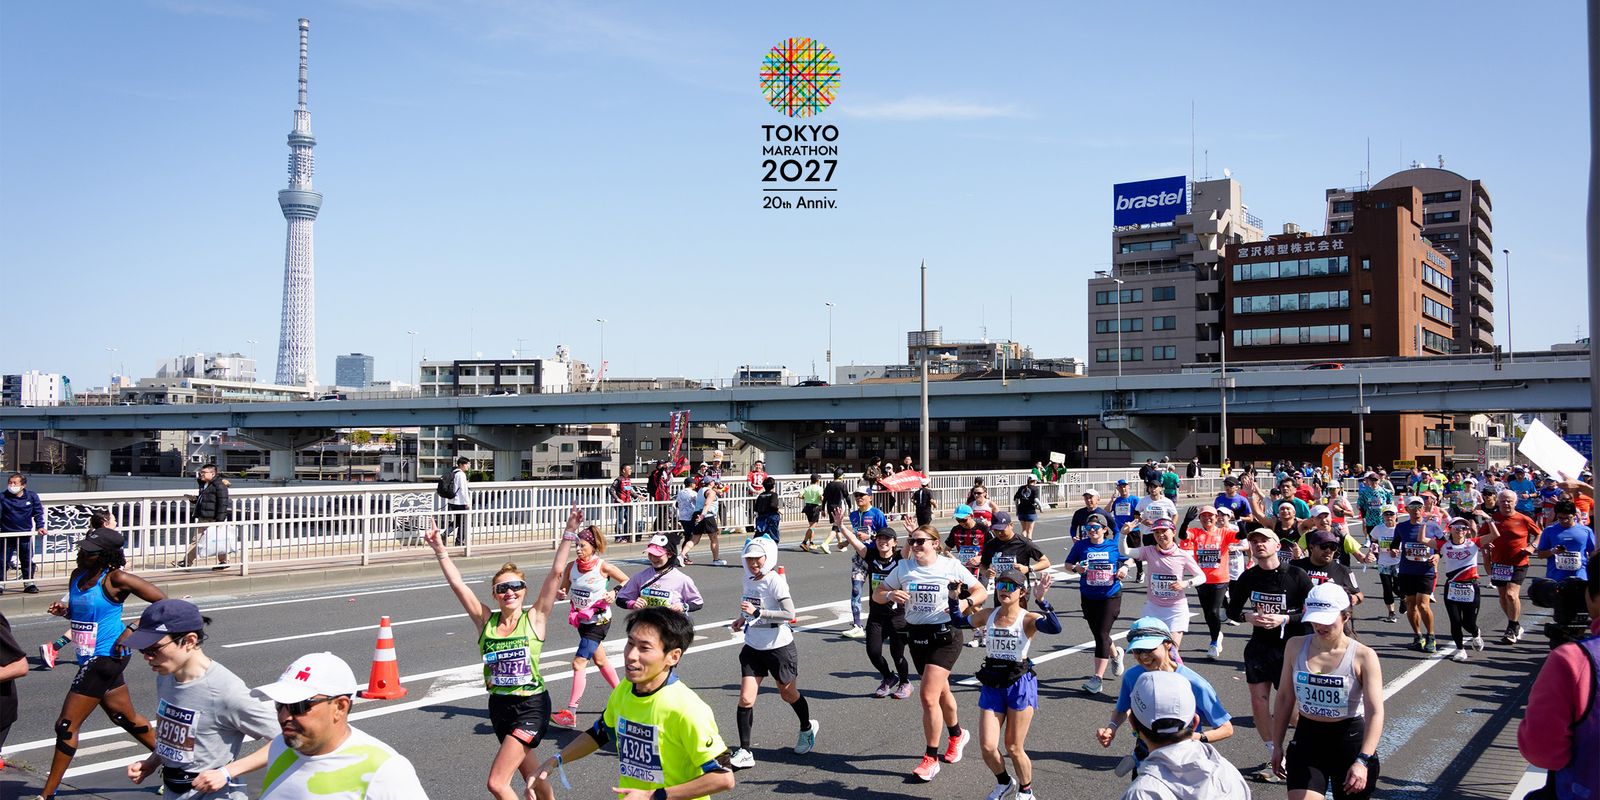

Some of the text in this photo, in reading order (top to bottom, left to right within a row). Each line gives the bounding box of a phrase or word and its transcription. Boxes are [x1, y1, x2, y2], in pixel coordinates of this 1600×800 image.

[1115, 187, 1184, 211] brastel
[1237, 238, 1345, 259] 宮沢模型株式会社
[914, 592, 937, 603] 15831
[992, 639, 1017, 651] 17545
[1309, 677, 1342, 687] 東京メトロ
[1304, 686, 1341, 704] 34098
[165, 707, 193, 721] 東京メトロ
[158, 719, 188, 744] 49798
[627, 724, 652, 738] 東京メトロ
[622, 738, 652, 764] 43245
[626, 765, 655, 782] STARTS
